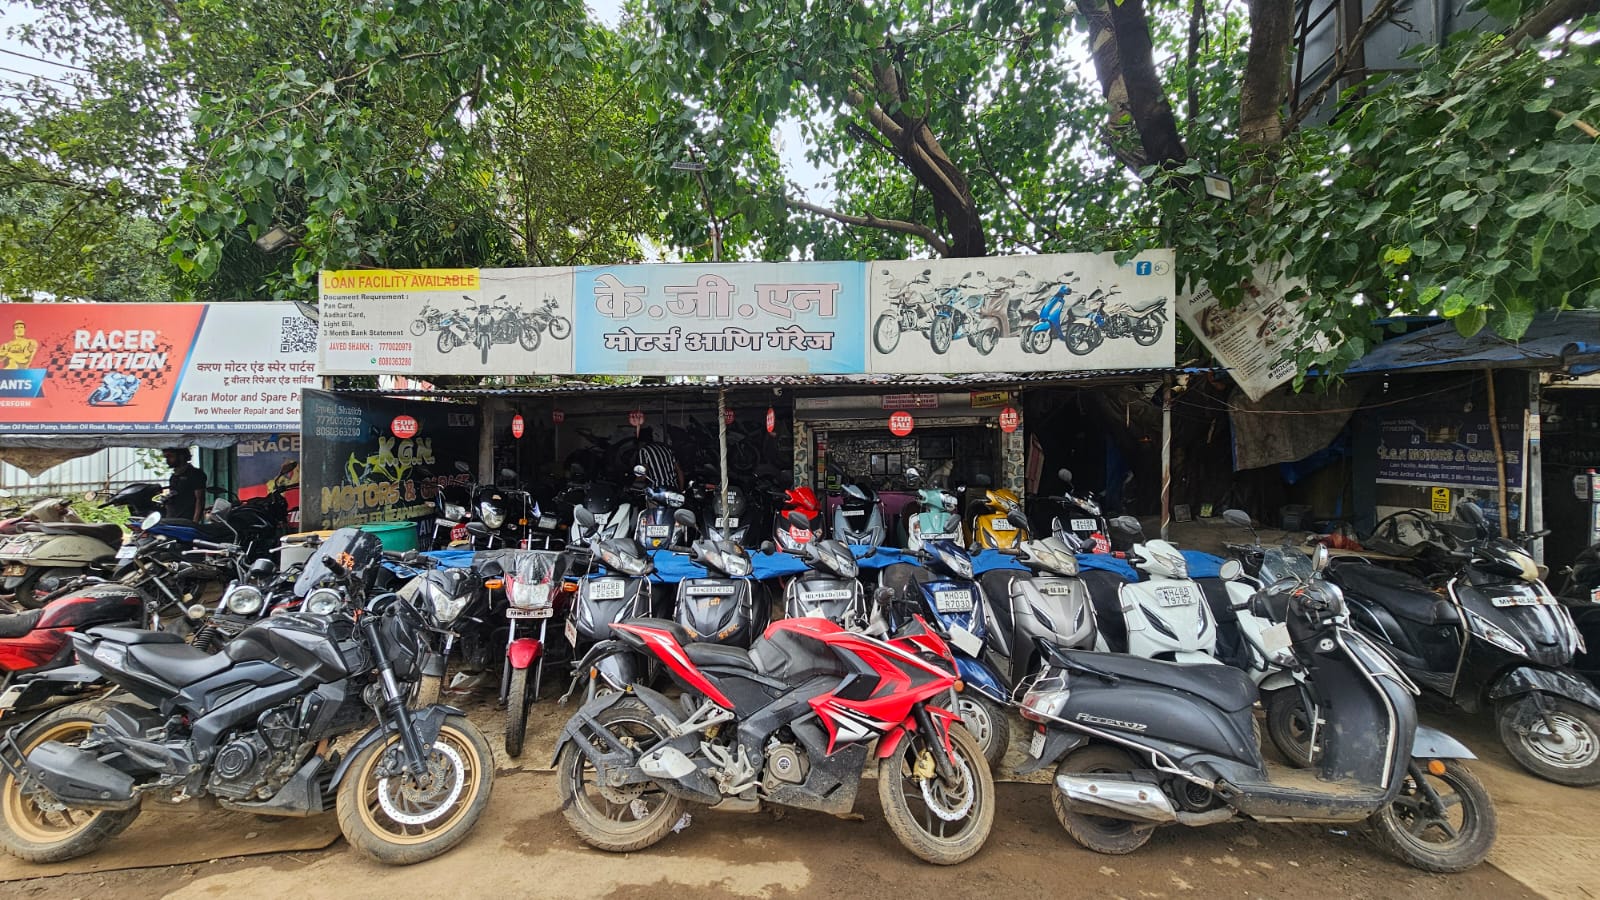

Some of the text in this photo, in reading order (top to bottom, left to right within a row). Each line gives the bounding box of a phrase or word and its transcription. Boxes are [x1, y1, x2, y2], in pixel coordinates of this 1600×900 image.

[324, 274, 475, 289] LOAN FACILITY AVAILABLE
[74, 329, 157, 350] RACER
[603, 326, 682, 352] मोटर्स
[684, 326, 764, 352] आणि
[329, 342, 347, 351] JAVED
[69, 352, 167, 369] STATION
[196, 363, 221, 372] करण
[224, 360, 247, 372] मोटर
[250, 360, 265, 373] एंड
[181, 392, 208, 402] Karan
[211, 392, 238, 402] Motor
[240, 392, 258, 402] and
[260, 392, 288, 404] Spare
[194, 407, 208, 415] Two
[211, 406, 241, 415] Wheeler
[243, 406, 268, 417] Repair
[269, 406, 284, 415] and
[321, 481, 400, 514] MOTORS
[943, 591, 969, 600] MH03D
[945, 600, 971, 608] R7030
